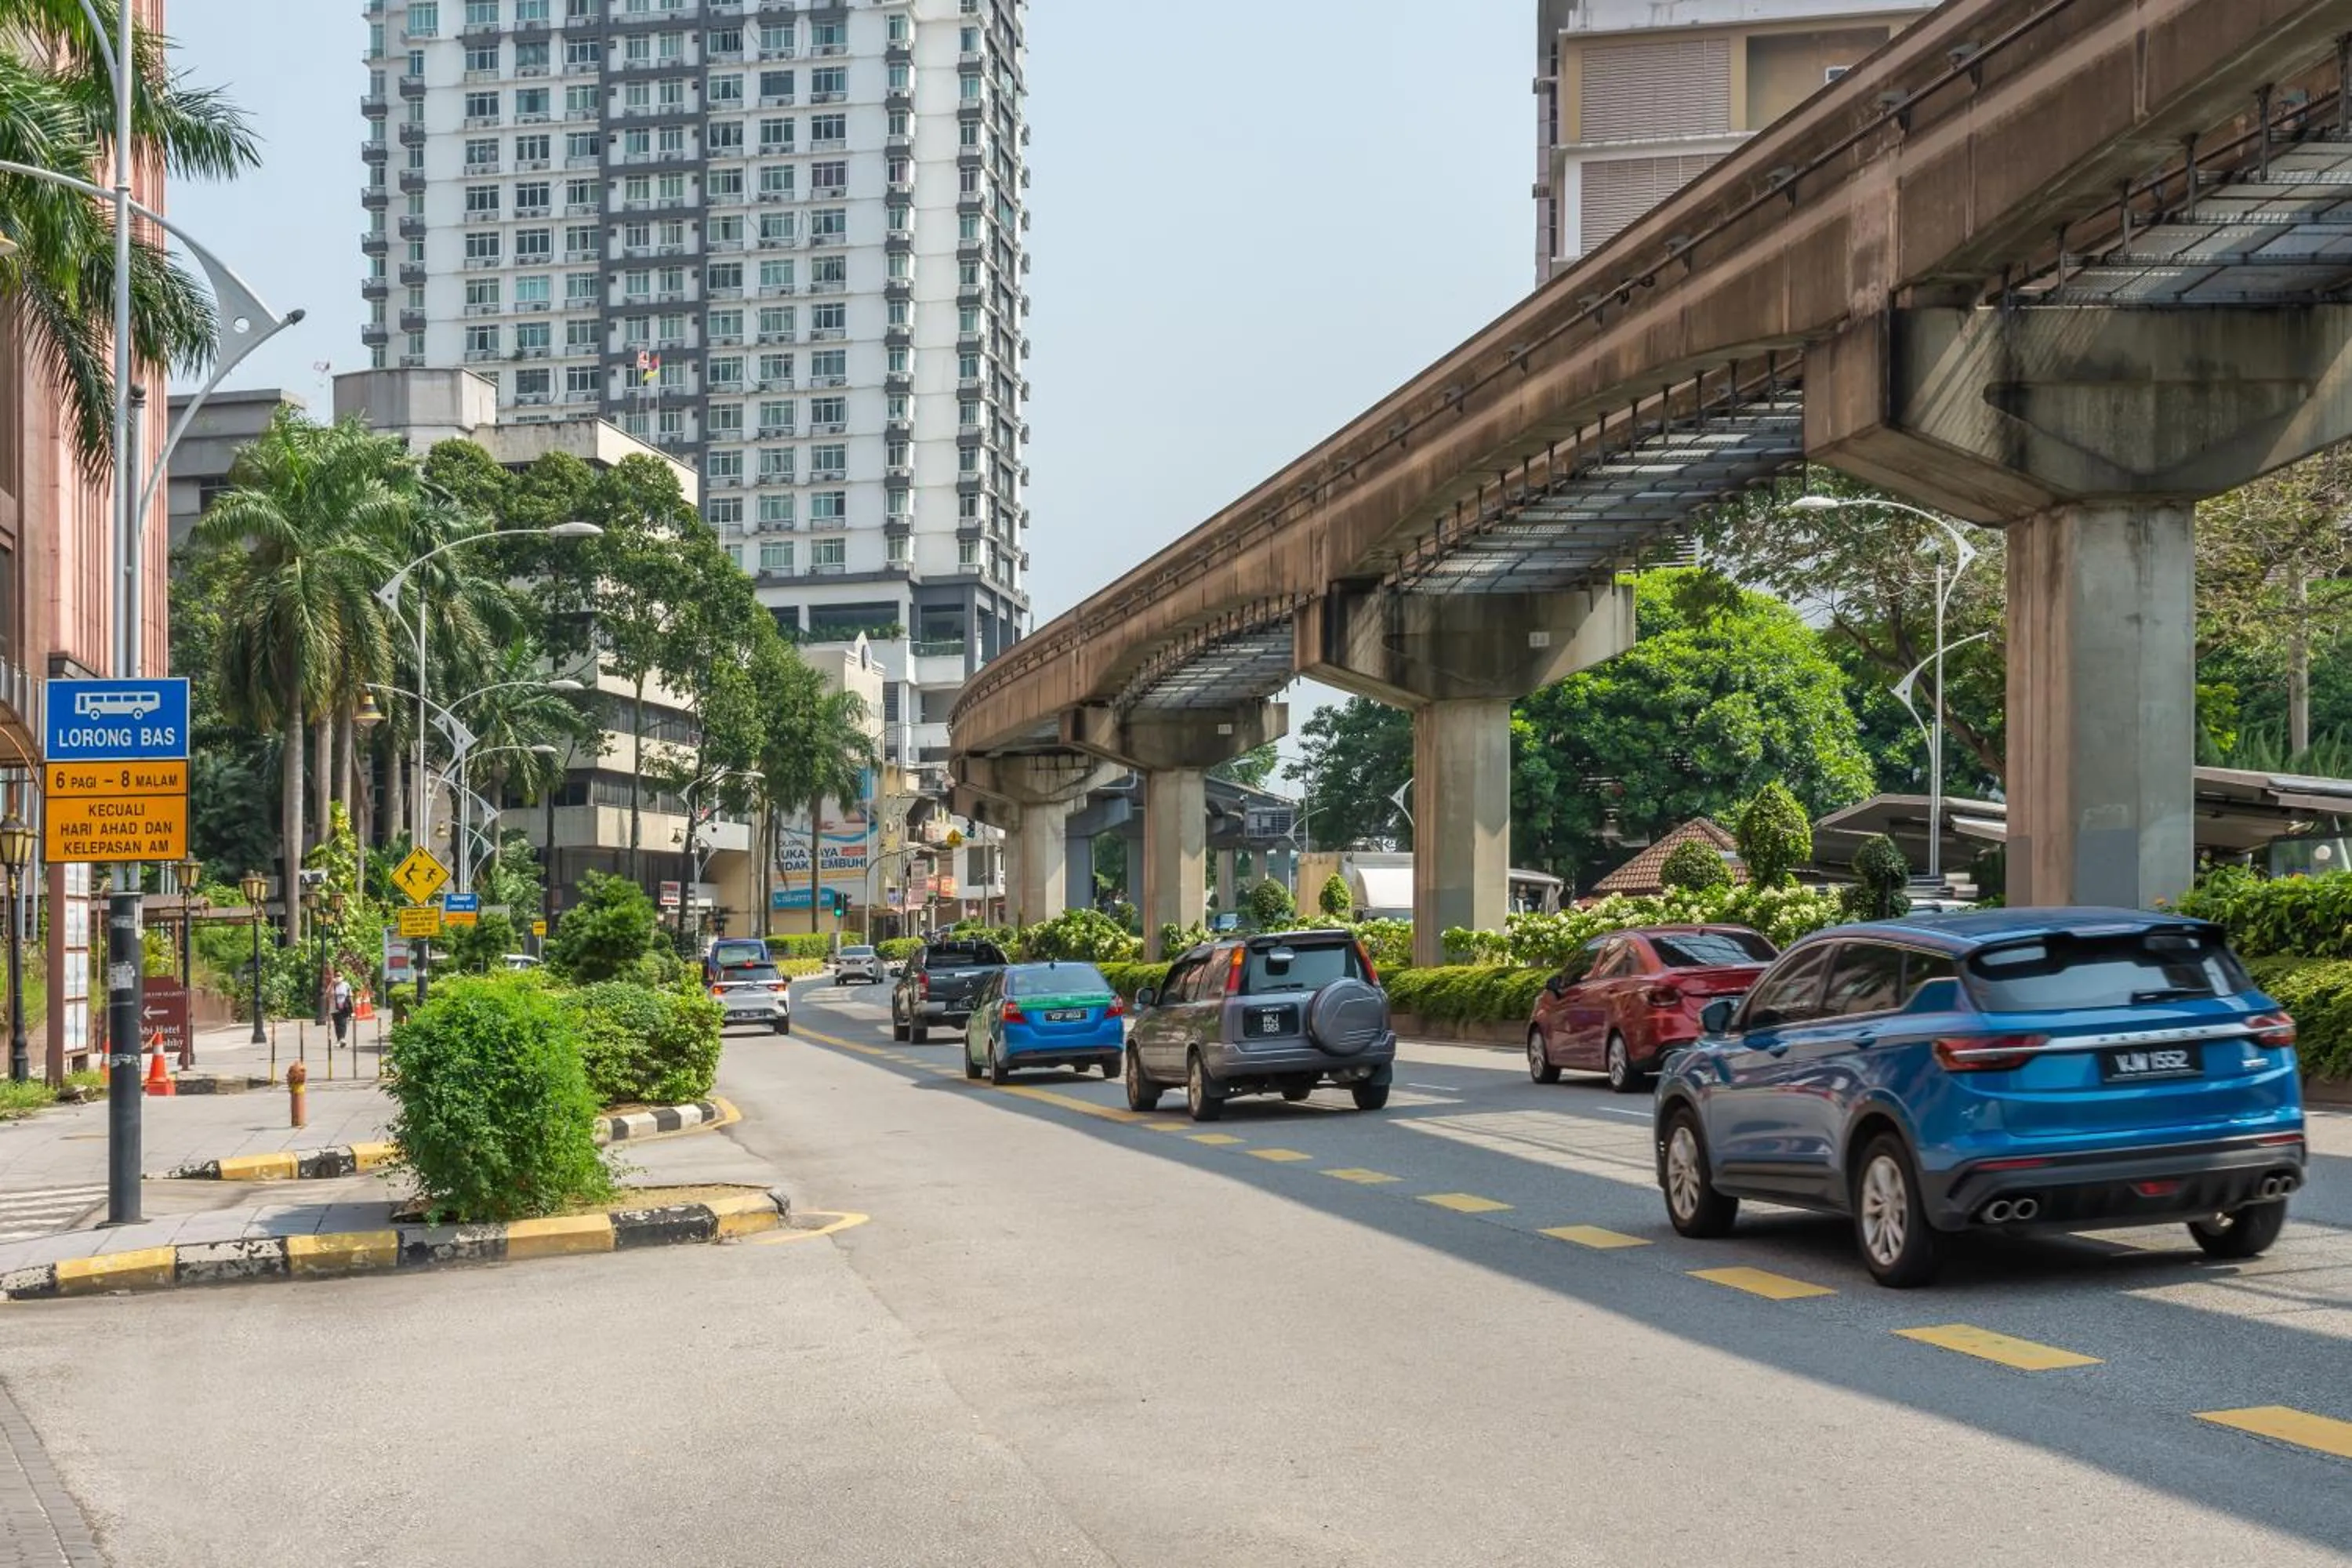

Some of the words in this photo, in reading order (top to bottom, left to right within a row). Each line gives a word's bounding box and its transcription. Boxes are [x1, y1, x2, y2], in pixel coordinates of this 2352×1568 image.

[58, 728, 132, 747] LORONG
[140, 727, 176, 746] BAS
[56, 771, 66, 789] 6
[71, 777, 97, 789] PAGI
[121, 770, 130, 788] 8
[135, 775, 179, 788] MALAM
[88, 803, 146, 817] KECUALI
[60, 823, 93, 837] HARI
[100, 822, 138, 836] AHAD
[144, 821, 172, 834] DAN
[64, 840, 142, 855] KELEPASAN
[148, 840, 169, 853] AM
